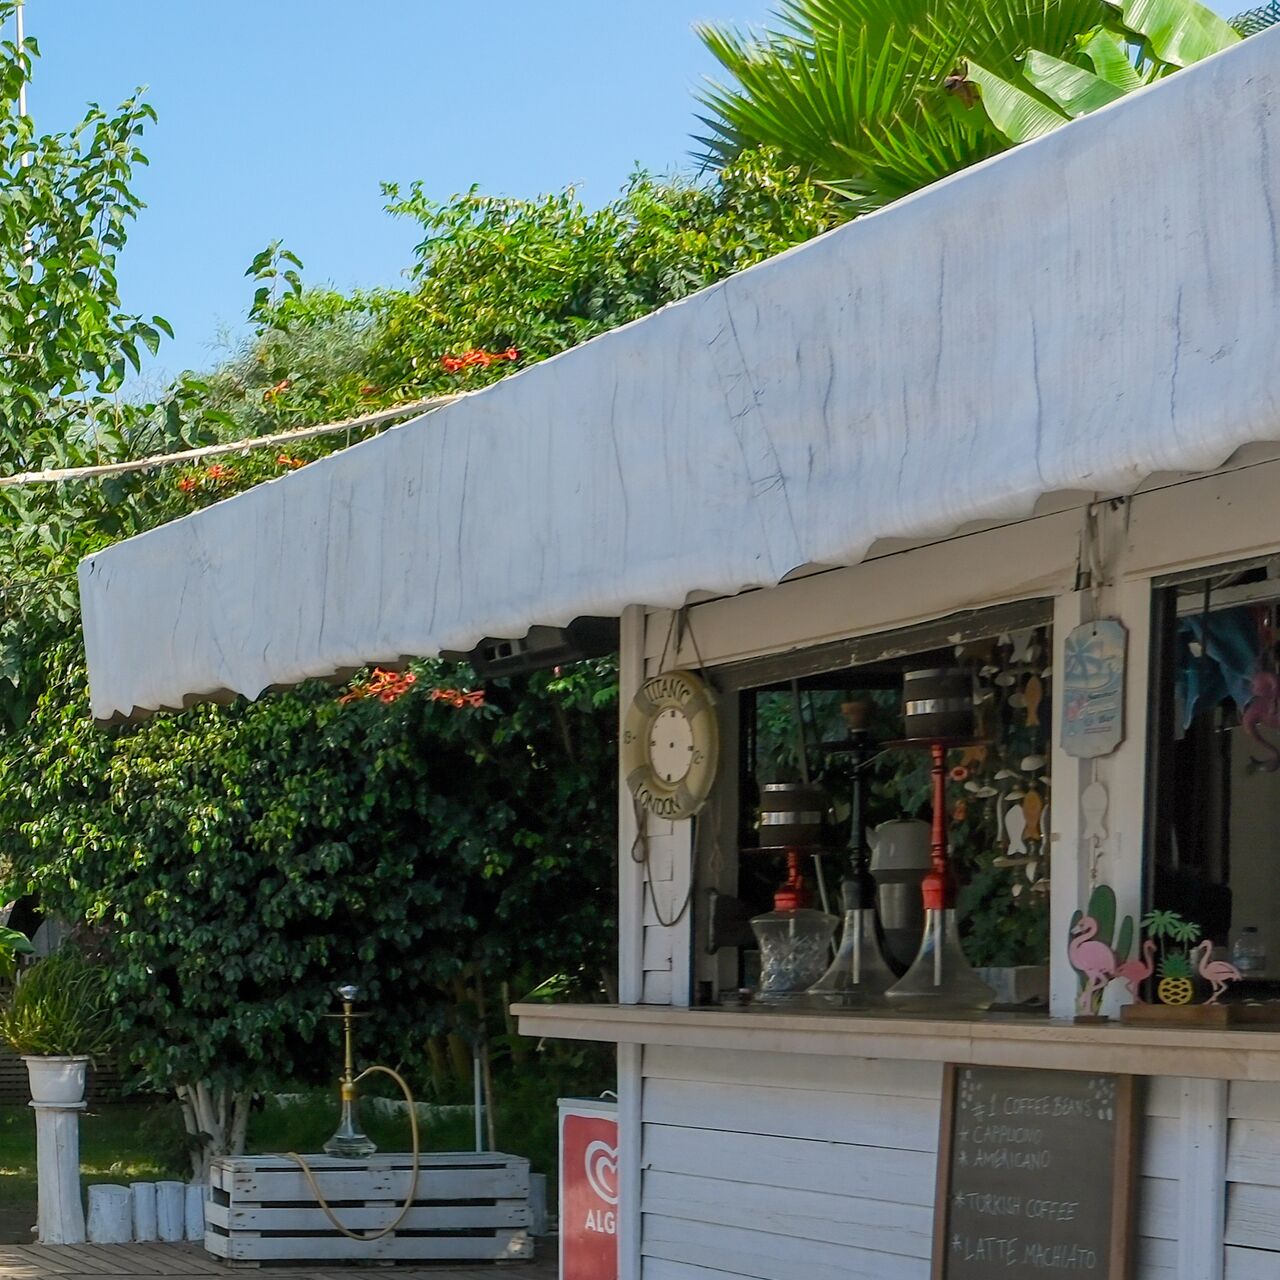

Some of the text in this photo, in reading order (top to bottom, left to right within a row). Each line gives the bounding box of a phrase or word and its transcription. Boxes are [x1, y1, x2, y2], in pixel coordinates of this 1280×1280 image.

[644, 678, 690, 704] TITANIC
[634, 782, 682, 816] LONDON
[1003, 1096, 1050, 1116] COFFEE
[1051, 1096, 1092, 1117] BEANS
[972, 1149, 1051, 1170] AMERICANO
[585, 1209, 615, 1234] ALG
[1026, 1199, 1079, 1221] COFFEE
[964, 1237, 1018, 1266] LATTE
